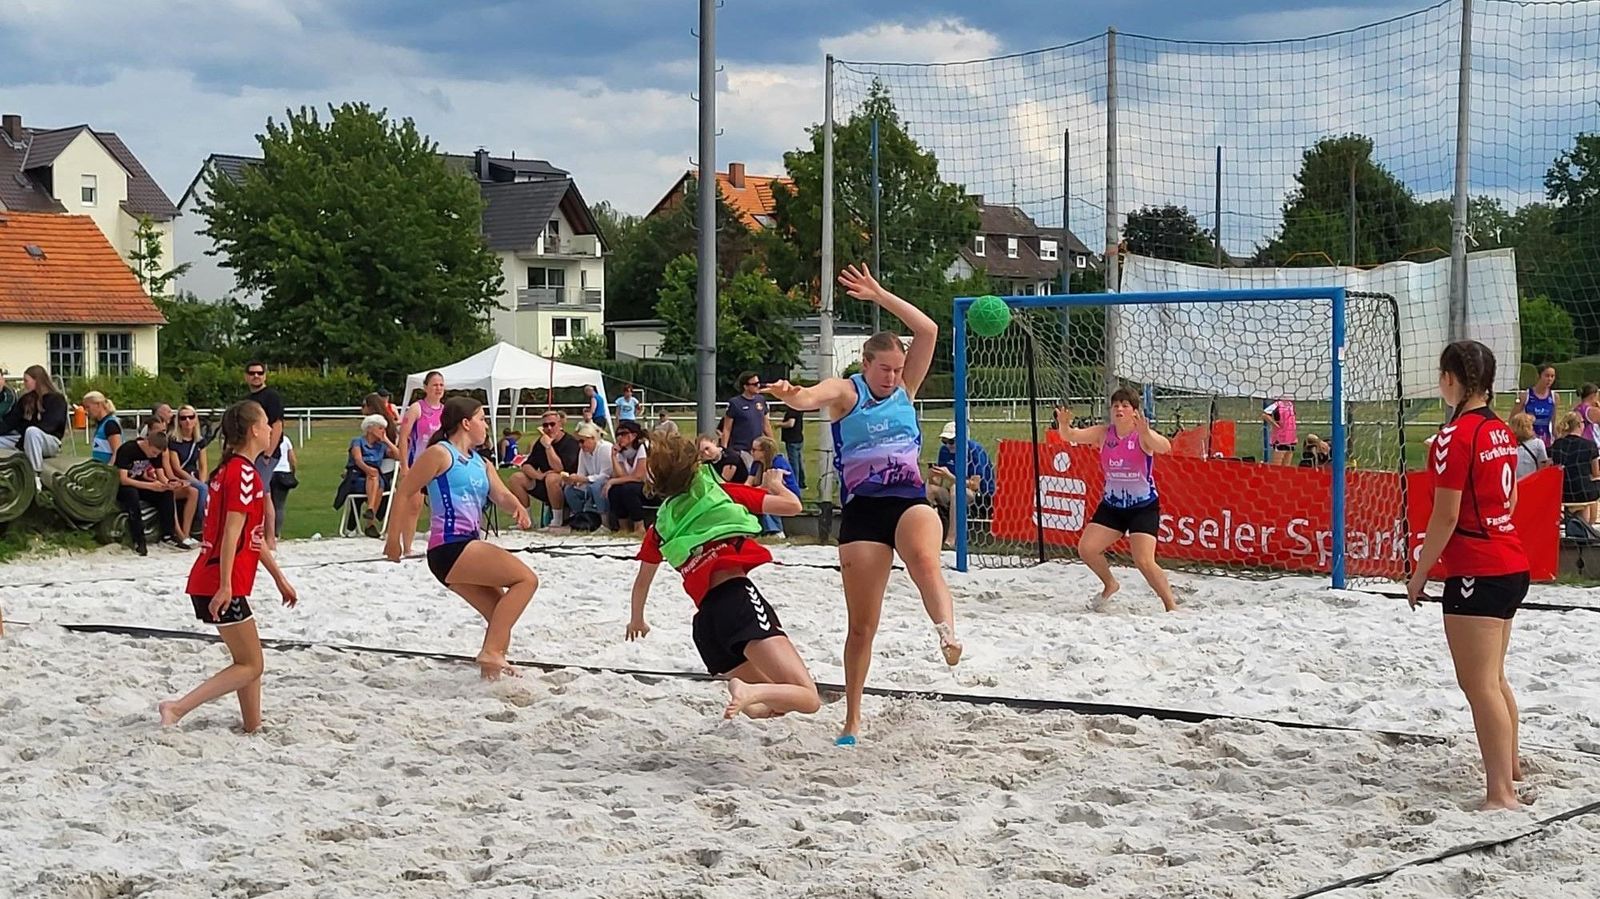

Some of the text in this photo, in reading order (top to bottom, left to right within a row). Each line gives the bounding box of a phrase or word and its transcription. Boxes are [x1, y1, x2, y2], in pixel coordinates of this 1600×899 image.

[1489, 429, 1510, 446] HSG
[1157, 510, 1429, 566] sseler Sparka
